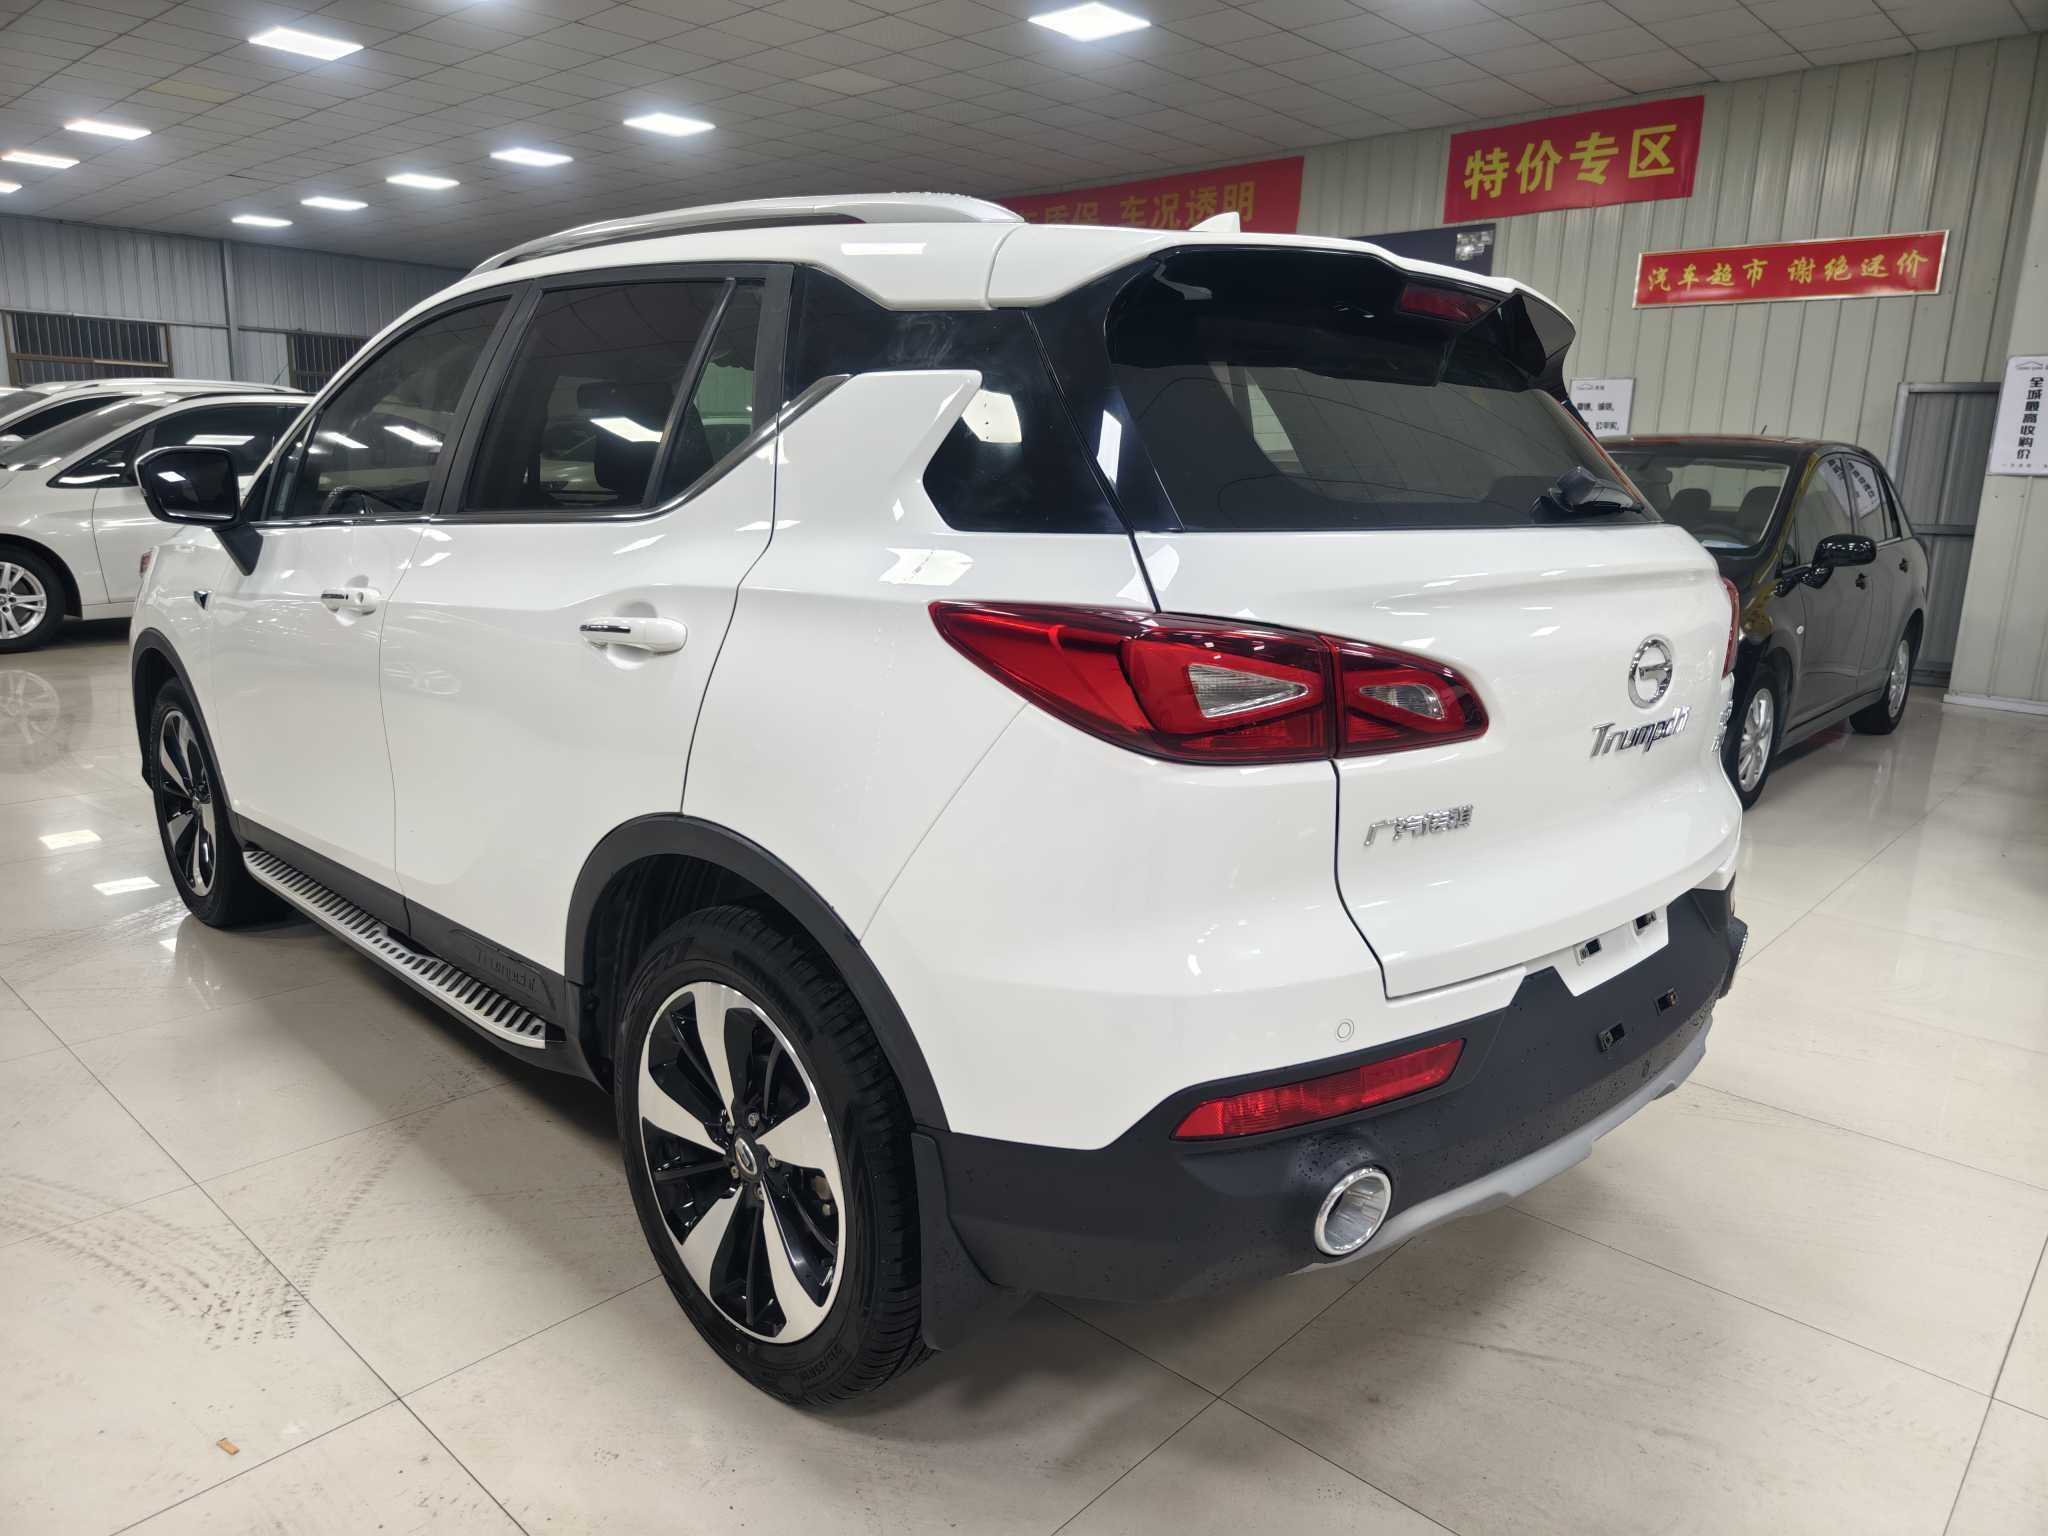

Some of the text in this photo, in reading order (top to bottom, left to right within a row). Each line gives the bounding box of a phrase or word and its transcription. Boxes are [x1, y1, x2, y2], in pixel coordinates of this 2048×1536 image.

[1463, 124, 1678, 200] 特价专区
[1119, 180, 1256, 229] 车况透明
[1647, 249, 1929, 291] 汽车超市 谢绝还价
[2016, 376, 2044, 460] 全城最高收购价
